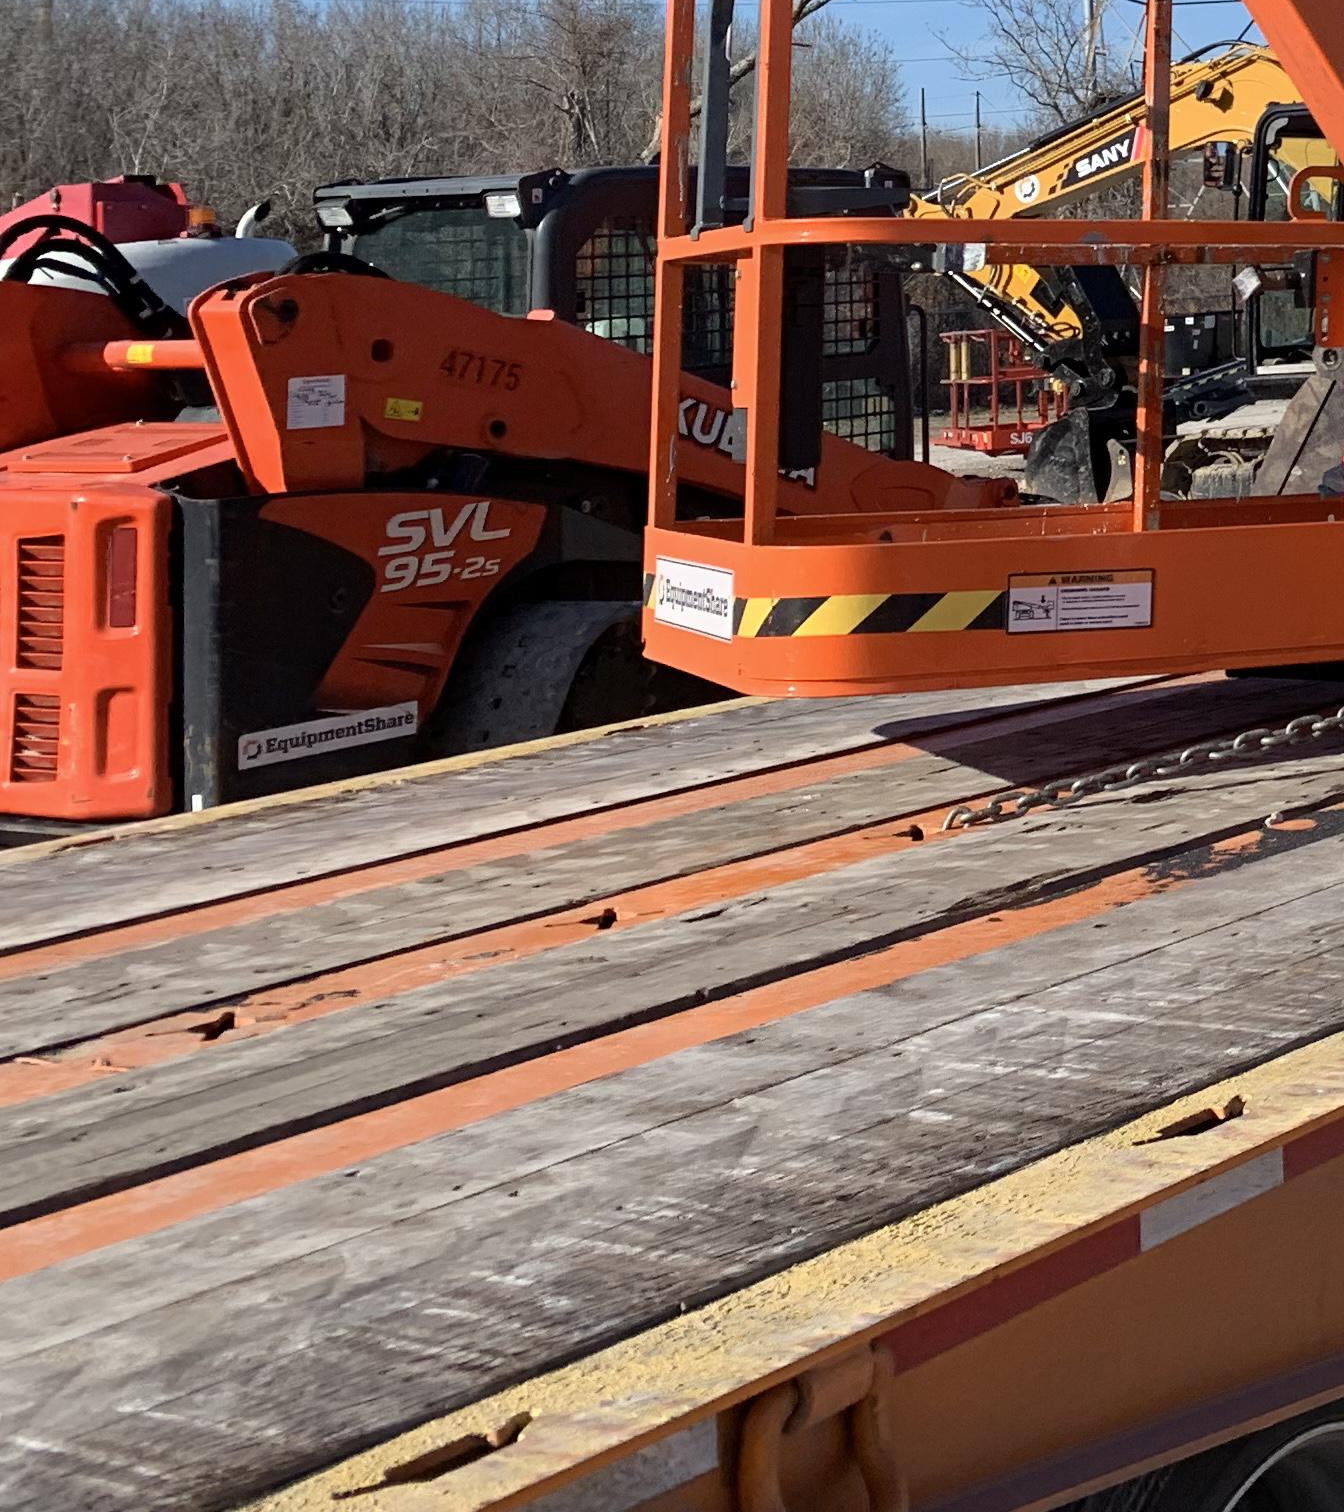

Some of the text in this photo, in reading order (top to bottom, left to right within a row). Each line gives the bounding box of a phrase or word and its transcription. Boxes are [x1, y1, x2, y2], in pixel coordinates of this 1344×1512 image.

[1075, 138, 1130, 179] SANY
[439, 348, 522, 391] 47175
[377, 501, 512, 557] SVL
[380, 549, 501, 593] 95-2s
[1061, 574, 1114, 584] WARNING
[666, 578, 729, 618] EquipmentShare
[265, 711, 415, 754] EquipmentShare
